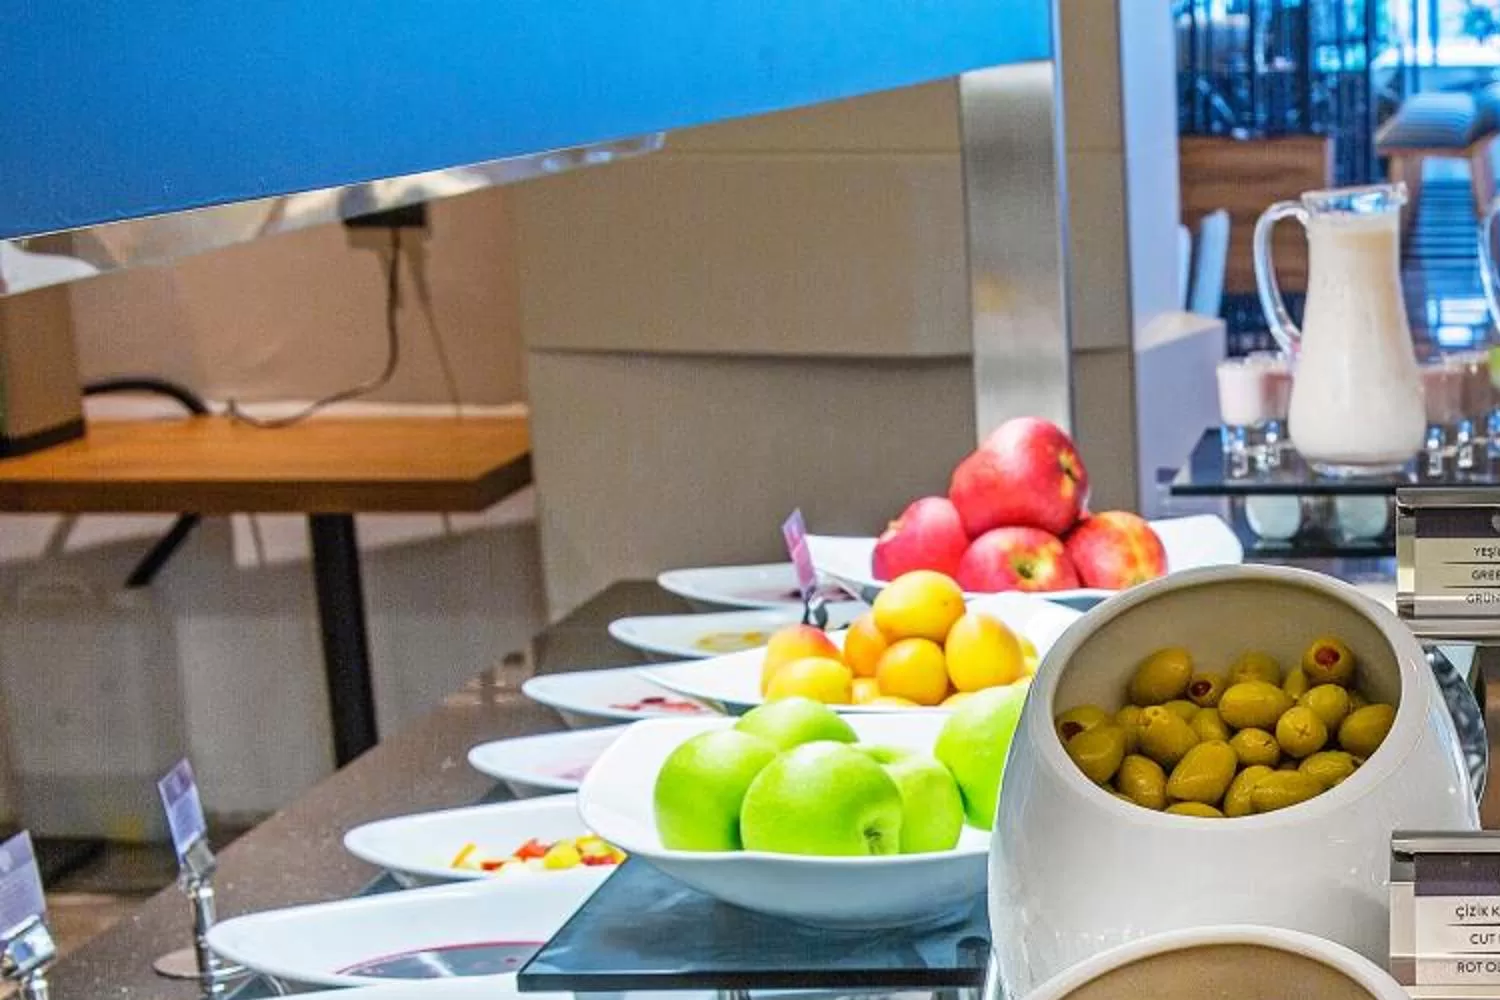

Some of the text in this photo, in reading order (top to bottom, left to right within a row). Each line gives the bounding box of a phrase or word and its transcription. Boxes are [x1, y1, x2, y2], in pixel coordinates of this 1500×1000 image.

[1456, 903, 1489, 920] ÇİZİK
[1470, 933, 1496, 945] CUT
[1457, 961, 1483, 973] ROT
